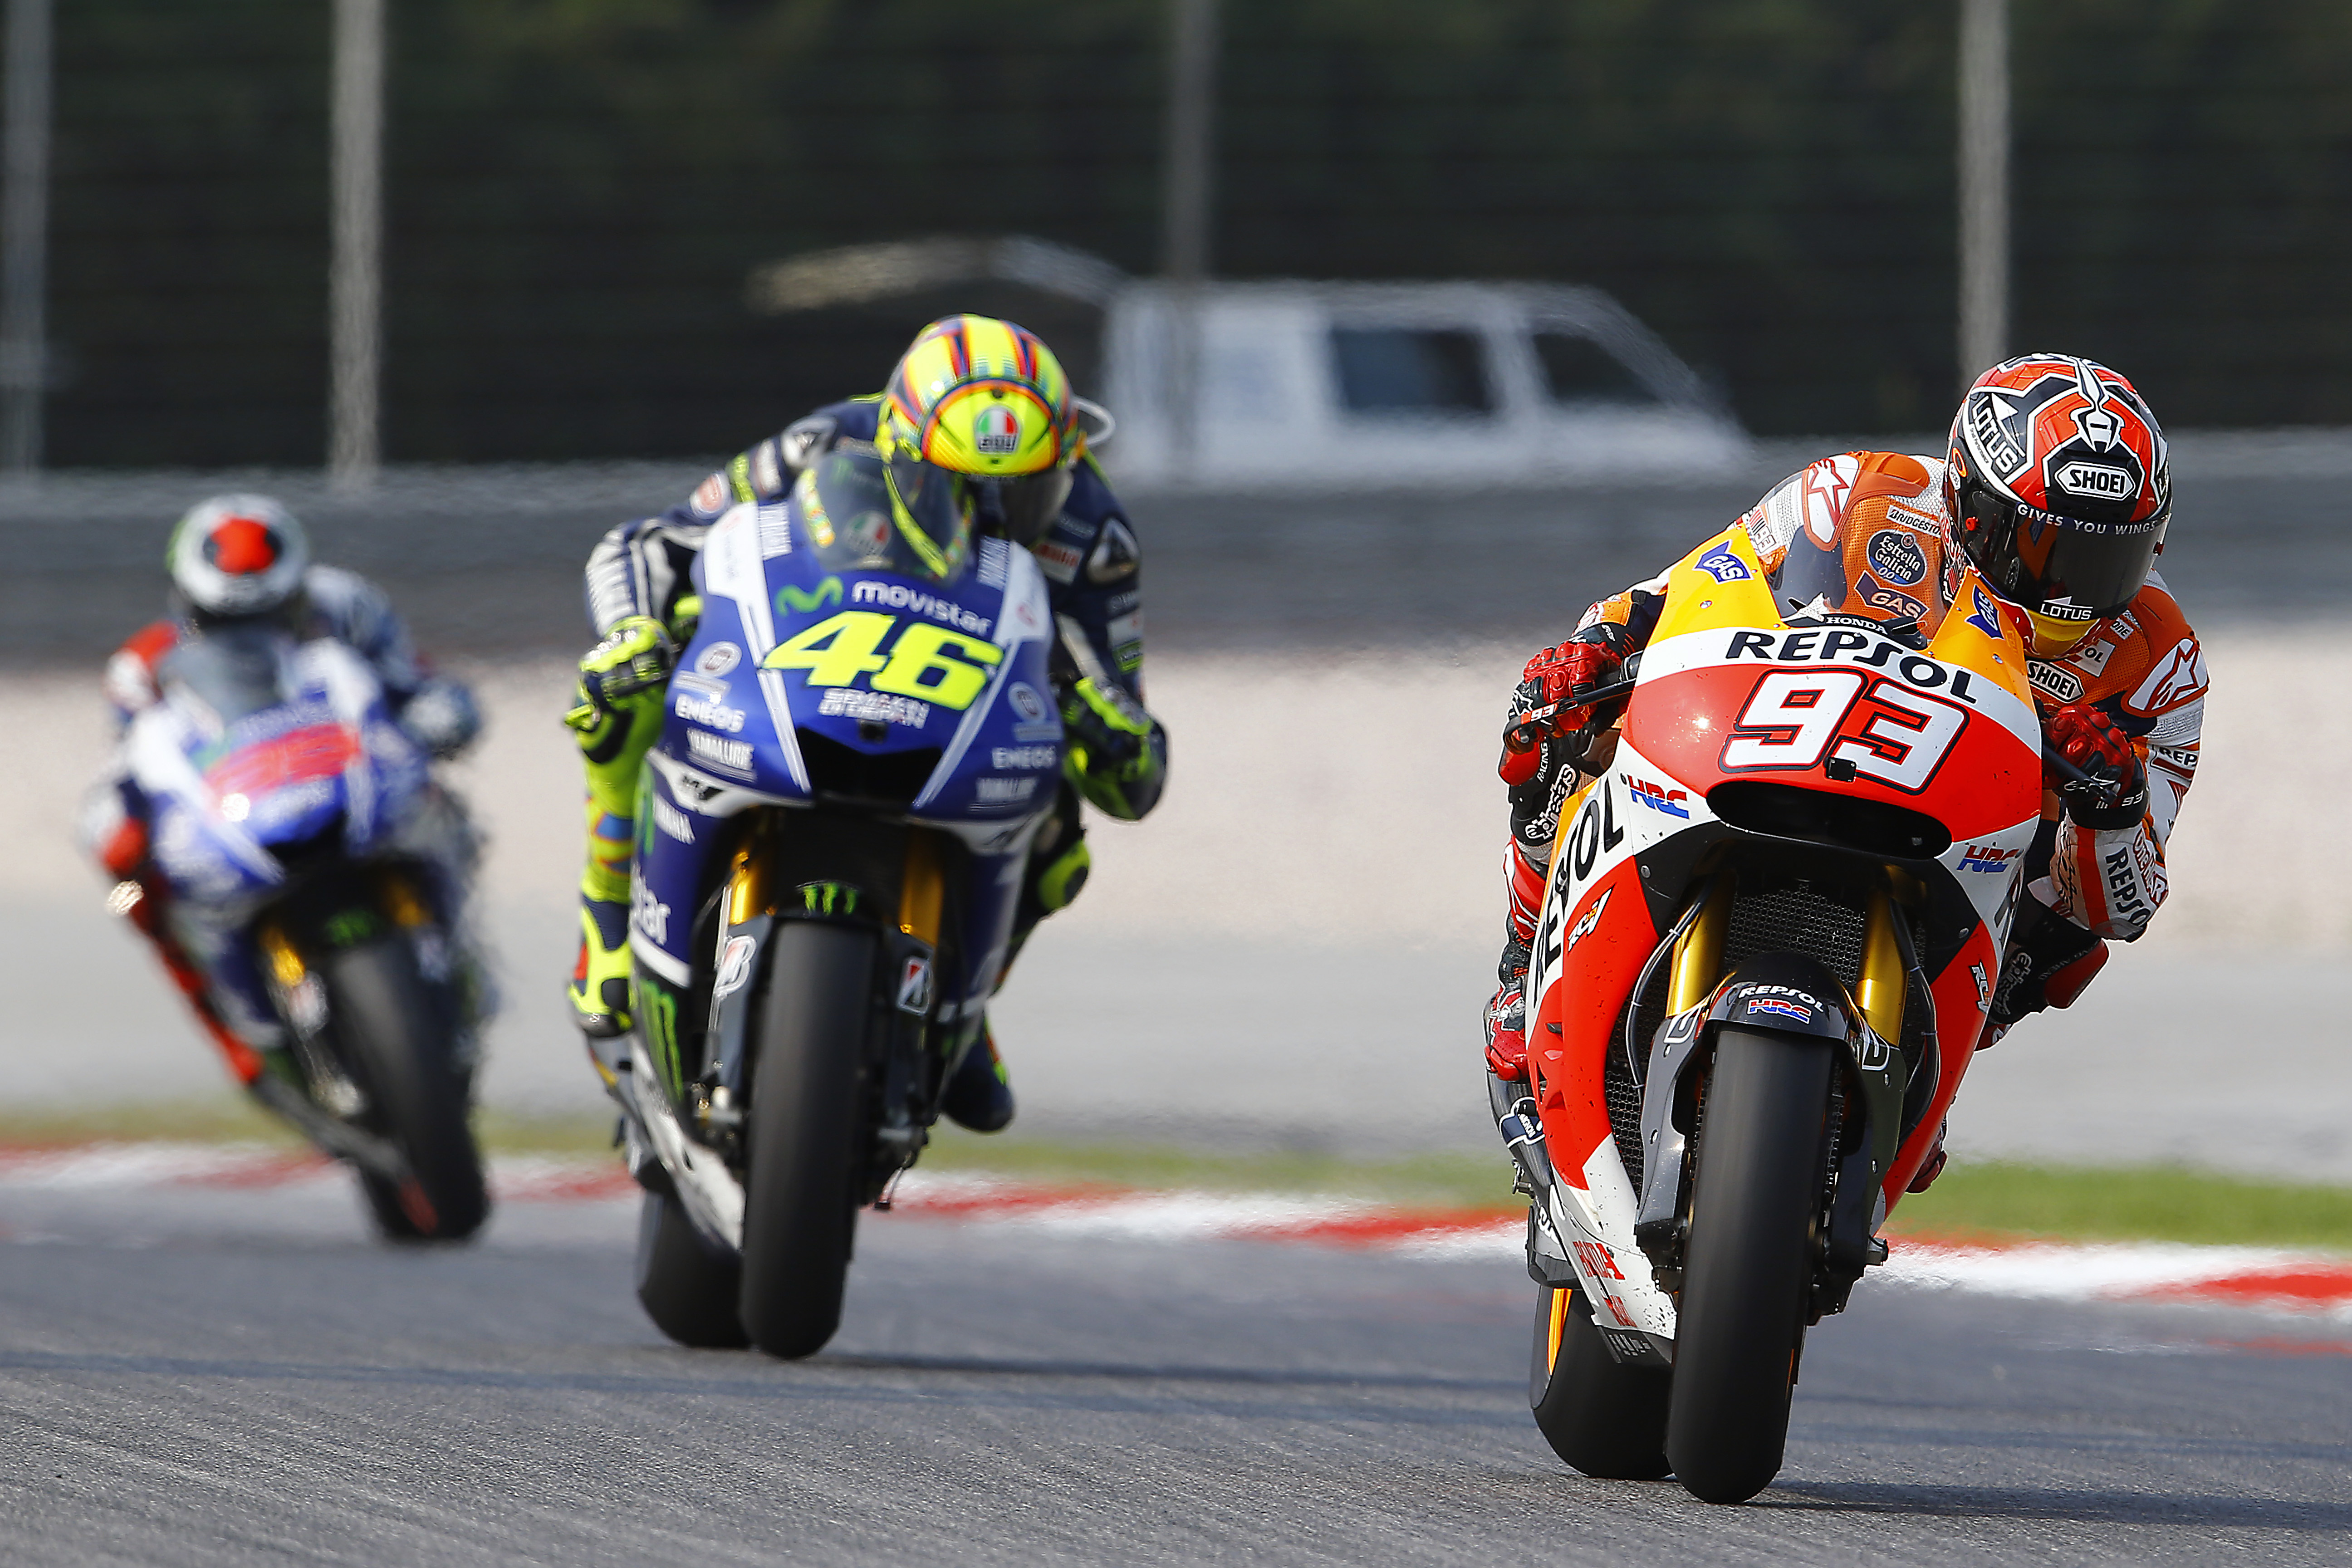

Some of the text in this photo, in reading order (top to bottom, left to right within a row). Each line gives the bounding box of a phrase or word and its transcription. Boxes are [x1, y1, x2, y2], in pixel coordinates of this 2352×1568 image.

[1972, 396, 2020, 474] LOTUS
[2069, 469, 2125, 494] SHOEI
[1889, 510, 1941, 535] BRIDGESTO
[2018, 504, 2156, 535] GIVES YOU WINGS
[1703, 554, 1744, 581] GAS
[1875, 548, 1912, 581] Galicia
[1879, 535, 1921, 571] Estrella
[852, 580, 992, 634] movistar
[1871, 592, 1921, 619] GAS
[1978, 591, 1997, 630] GAS
[2040, 604, 2092, 620] LOTUS
[1826, 616, 1888, 634] HONDA
[761, 610, 1004, 711] 46
[1726, 631, 1976, 704] REPSOL
[2027, 662, 2076, 698] SHOEI
[1530, 704, 1555, 720] 93
[1720, 669, 1968, 795] 93
[1537, 742, 1548, 782] RACING
[2159, 747, 2198, 767] REP
[1628, 774, 1690, 819] HRC
[2122, 790, 2144, 807] 93
[2105, 846, 2151, 927] REPSO
[1738, 985, 1824, 1013] REPSOL
[1747, 999, 1812, 1024] HRC
